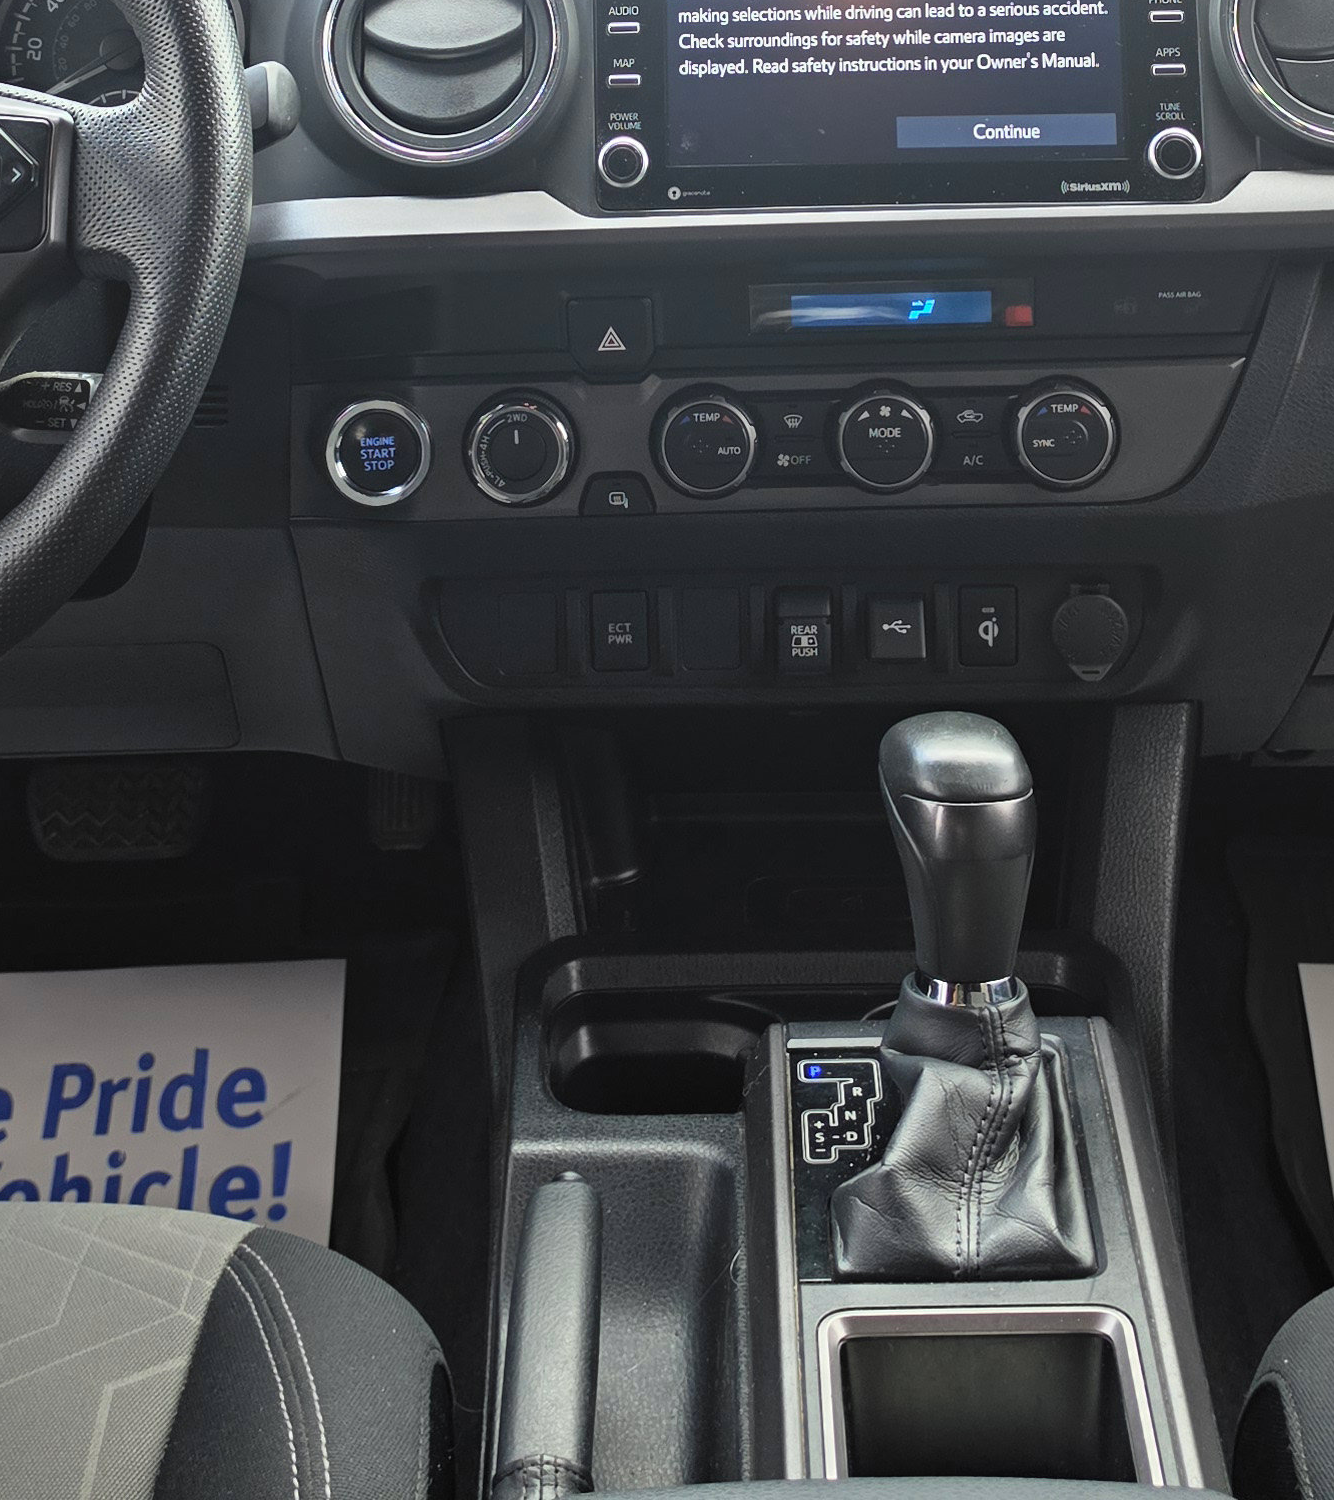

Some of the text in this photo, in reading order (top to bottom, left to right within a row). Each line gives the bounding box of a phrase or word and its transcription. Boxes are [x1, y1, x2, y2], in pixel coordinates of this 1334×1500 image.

[608, 6, 639, 16] AUDIO
[678, 0, 1109, 25] making selections while driving can lead to a serious accident.
[679, 28, 1066, 50] Check surroundings for safety while camera images are
[27, 37, 43, 61] 20
[1156, 48, 1181, 57] APPS
[613, 59, 635, 68] MAP
[679, 52, 1100, 78] displayed. Read safety instructions in your Owner's Manual.
[1160, 103, 1181, 111] TUNE
[610, 112, 639, 121] POWER
[1156, 111, 1185, 121] SCROLL
[608, 121, 642, 130] VOLUME
[973, 123, 1041, 140] Continue
[1175, 291, 1187, 299] AIR
[1187, 291, 1202, 299] BAG
[53, 381, 73, 392] RES
[1051, 403, 1079, 413] TEMP
[507, 413, 528, 424] 2WD
[693, 412, 721, 423] TEMP
[47, 418, 67, 429] SET
[869, 427, 902, 439] MODE
[360, 436, 395, 447] ENGINE
[1032, 438, 1055, 448] SYNC
[360, 448, 396, 460] START
[717, 446, 741, 455] AUTO
[791, 455, 812, 465] OFF
[963, 454, 984, 466] A/C
[364, 460, 395, 472] STOP
[608, 622, 632, 633] ECT
[790, 625, 818, 635] REAR
[608, 634, 633, 645] PWR
[791, 648, 818, 657] PUSH
[809, 1065, 822, 1078] P
[42, 1046, 268, 1140] Pride
[852, 1087, 863, 1097] R
[844, 1110, 857, 1121] N
[815, 1131, 858, 1143] S D
